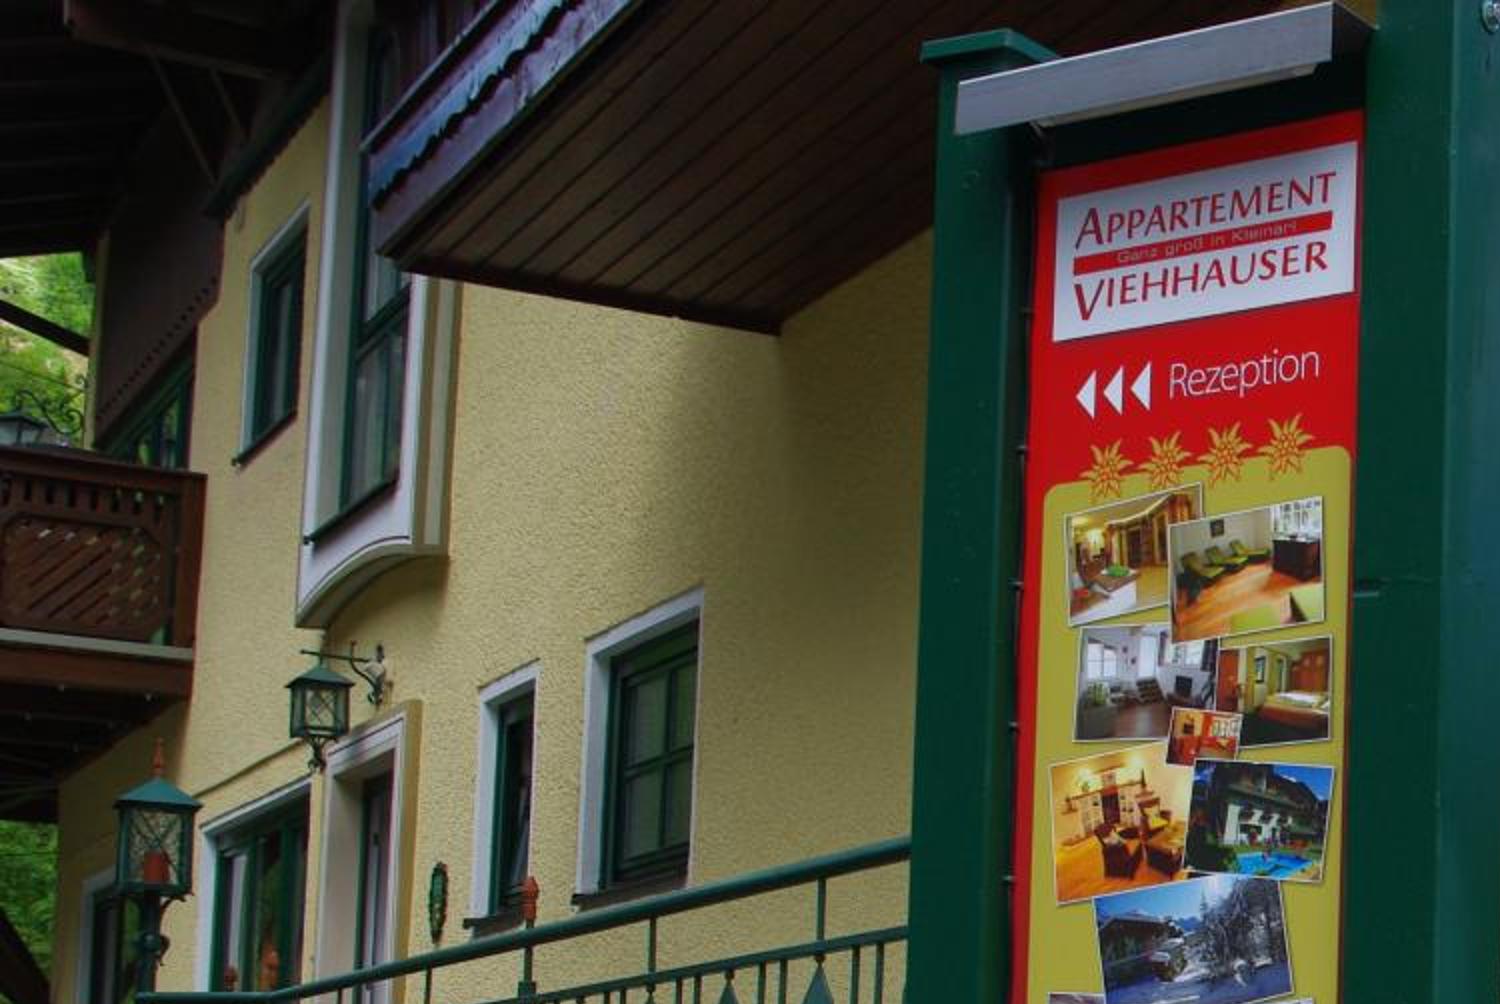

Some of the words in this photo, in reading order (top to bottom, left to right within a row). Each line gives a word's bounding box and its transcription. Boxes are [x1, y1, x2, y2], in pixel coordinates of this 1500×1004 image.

[1075, 171, 1337, 249] APPARTEMENT
[1116, 246, 1158, 264] Ganz
[1210, 231, 1226, 247] in
[1074, 241, 1329, 321] VIEHHAUSER
[1169, 348, 1320, 399] Rezeption
